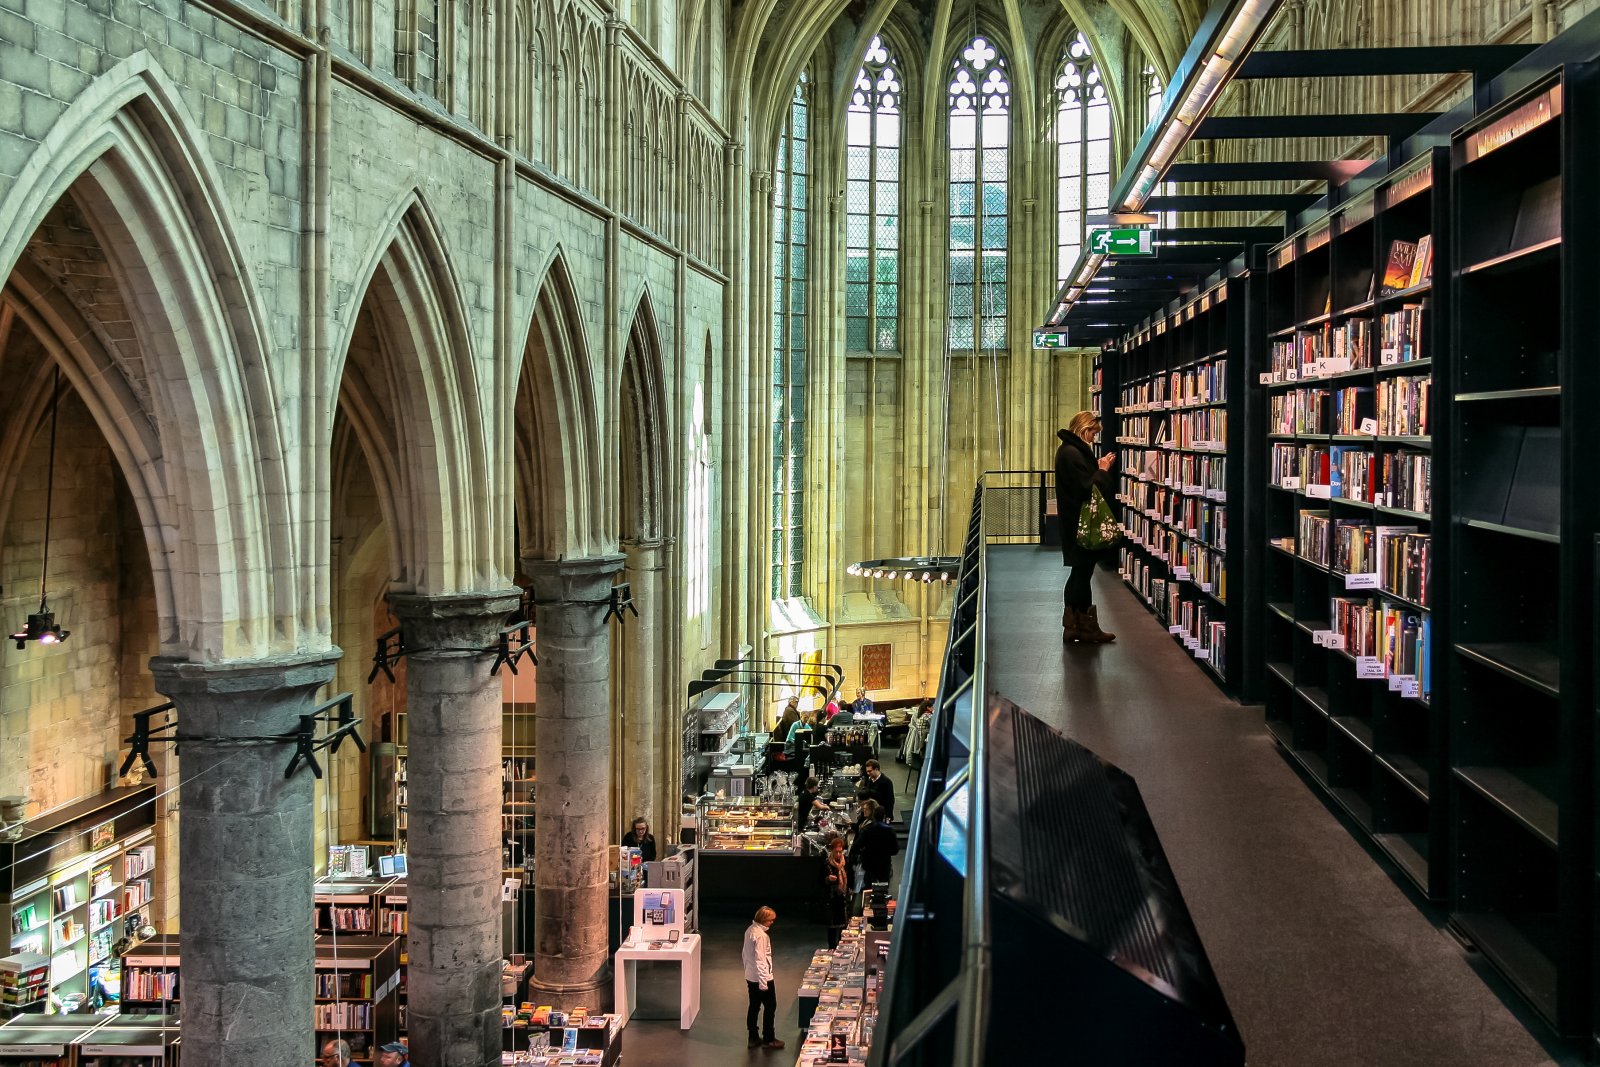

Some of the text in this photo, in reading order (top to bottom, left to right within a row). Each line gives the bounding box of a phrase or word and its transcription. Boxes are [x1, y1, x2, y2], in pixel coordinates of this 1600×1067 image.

[1386, 353, 1393, 362] R
[1320, 361, 1326, 369] K
[1365, 423, 1372, 432] S
[1309, 488, 1315, 496] L
[1317, 634, 1323, 642] N
